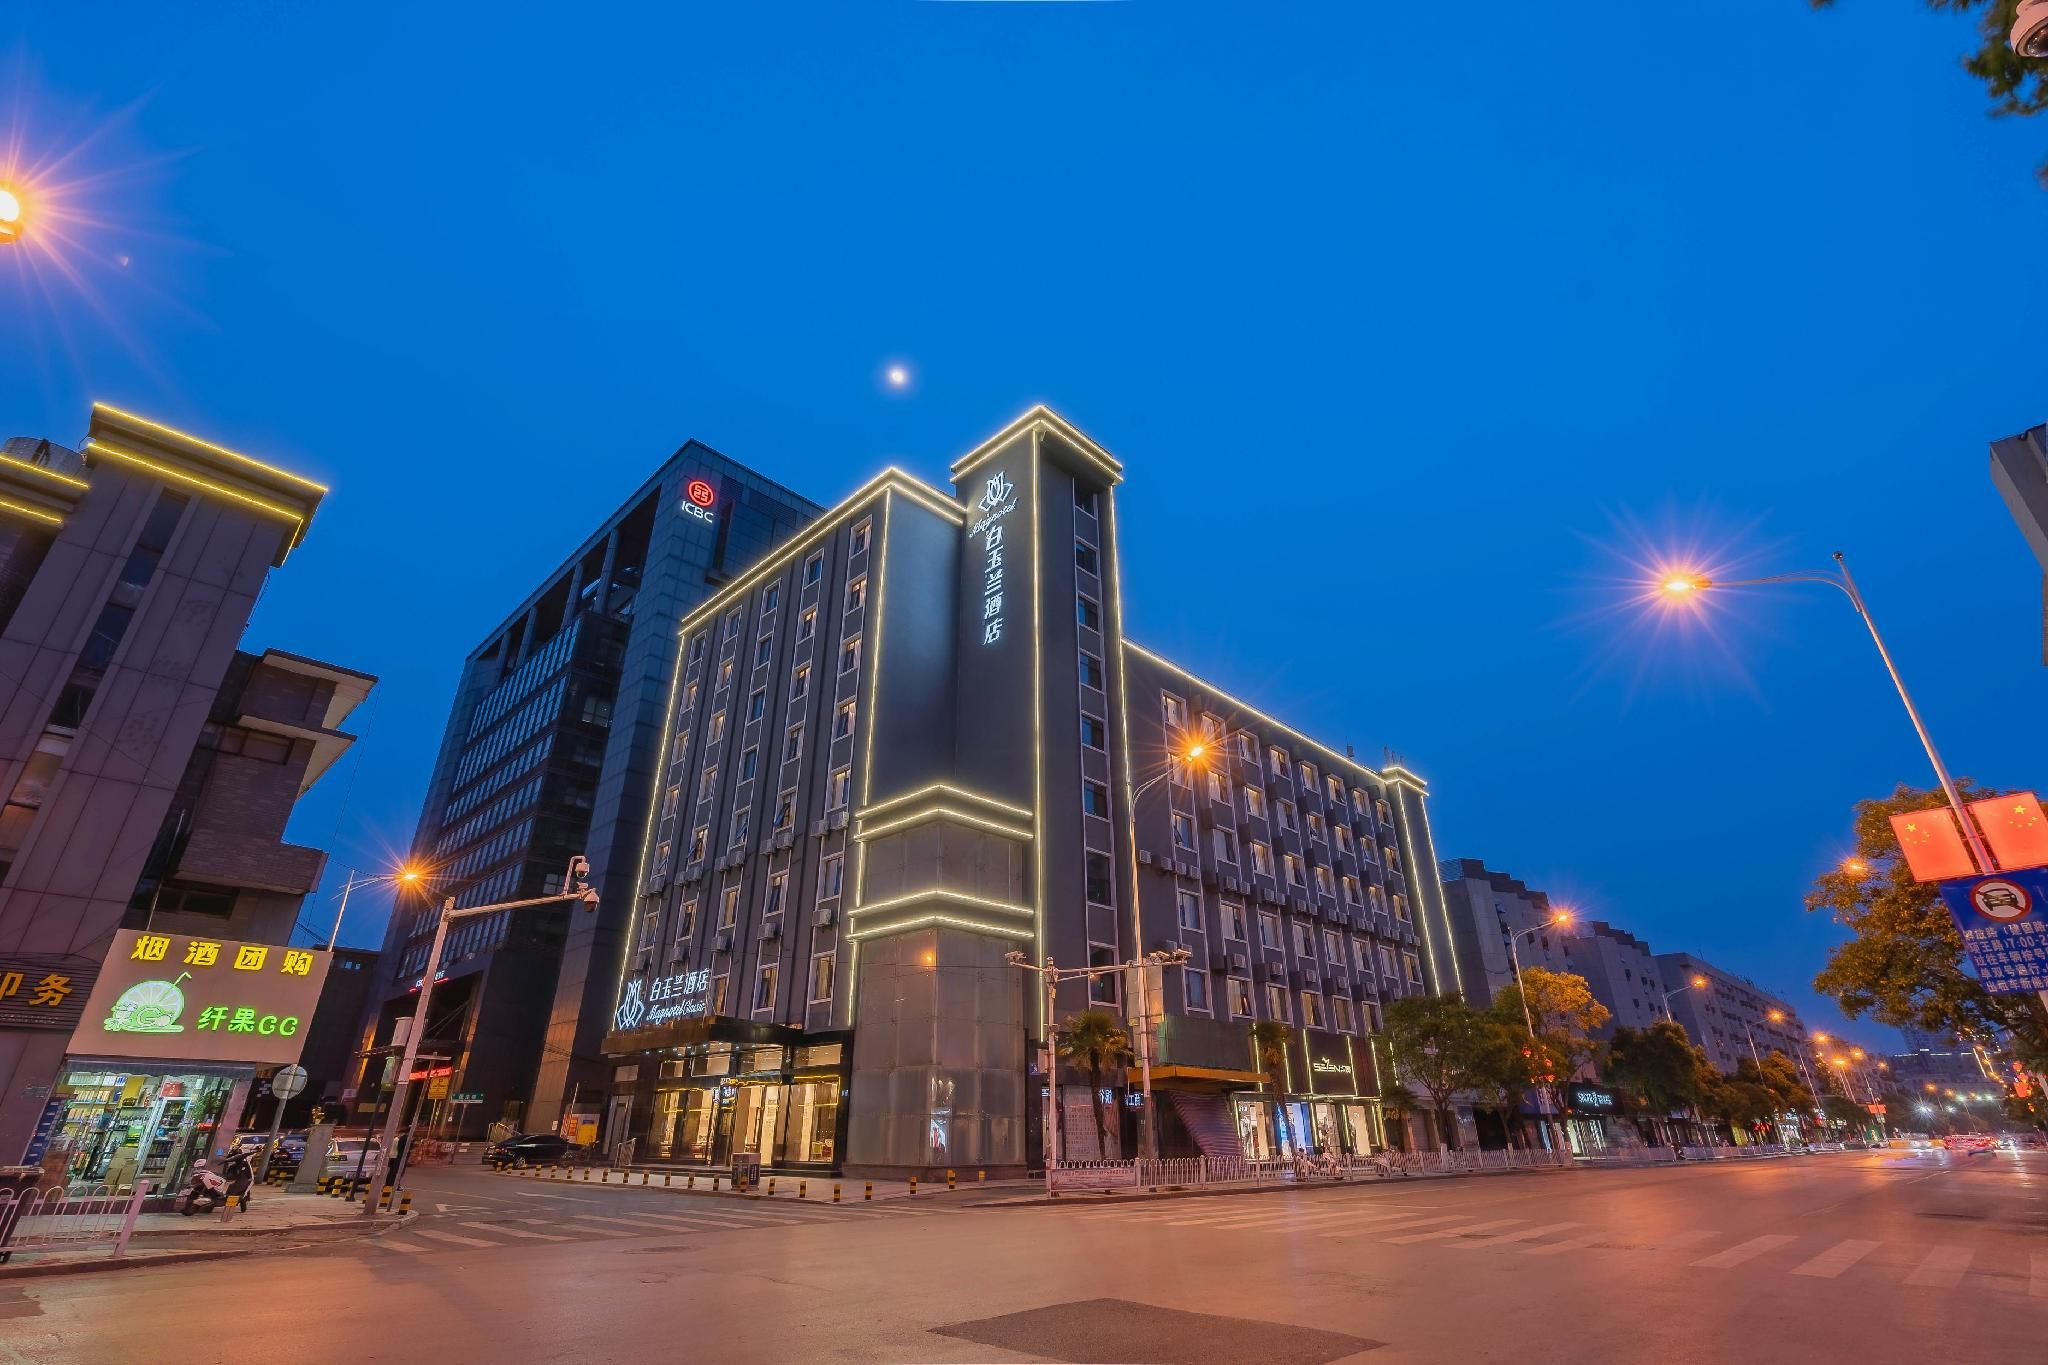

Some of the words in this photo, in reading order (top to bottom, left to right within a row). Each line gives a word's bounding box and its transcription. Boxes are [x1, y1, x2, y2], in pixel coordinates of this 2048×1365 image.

[682, 501, 714, 523] ICBC
[984, 524, 1003, 645] 白玉兰酒店
[131, 935, 314, 976] 烟酒团购
[650, 968, 710, 1001] 白玉兰酒店
